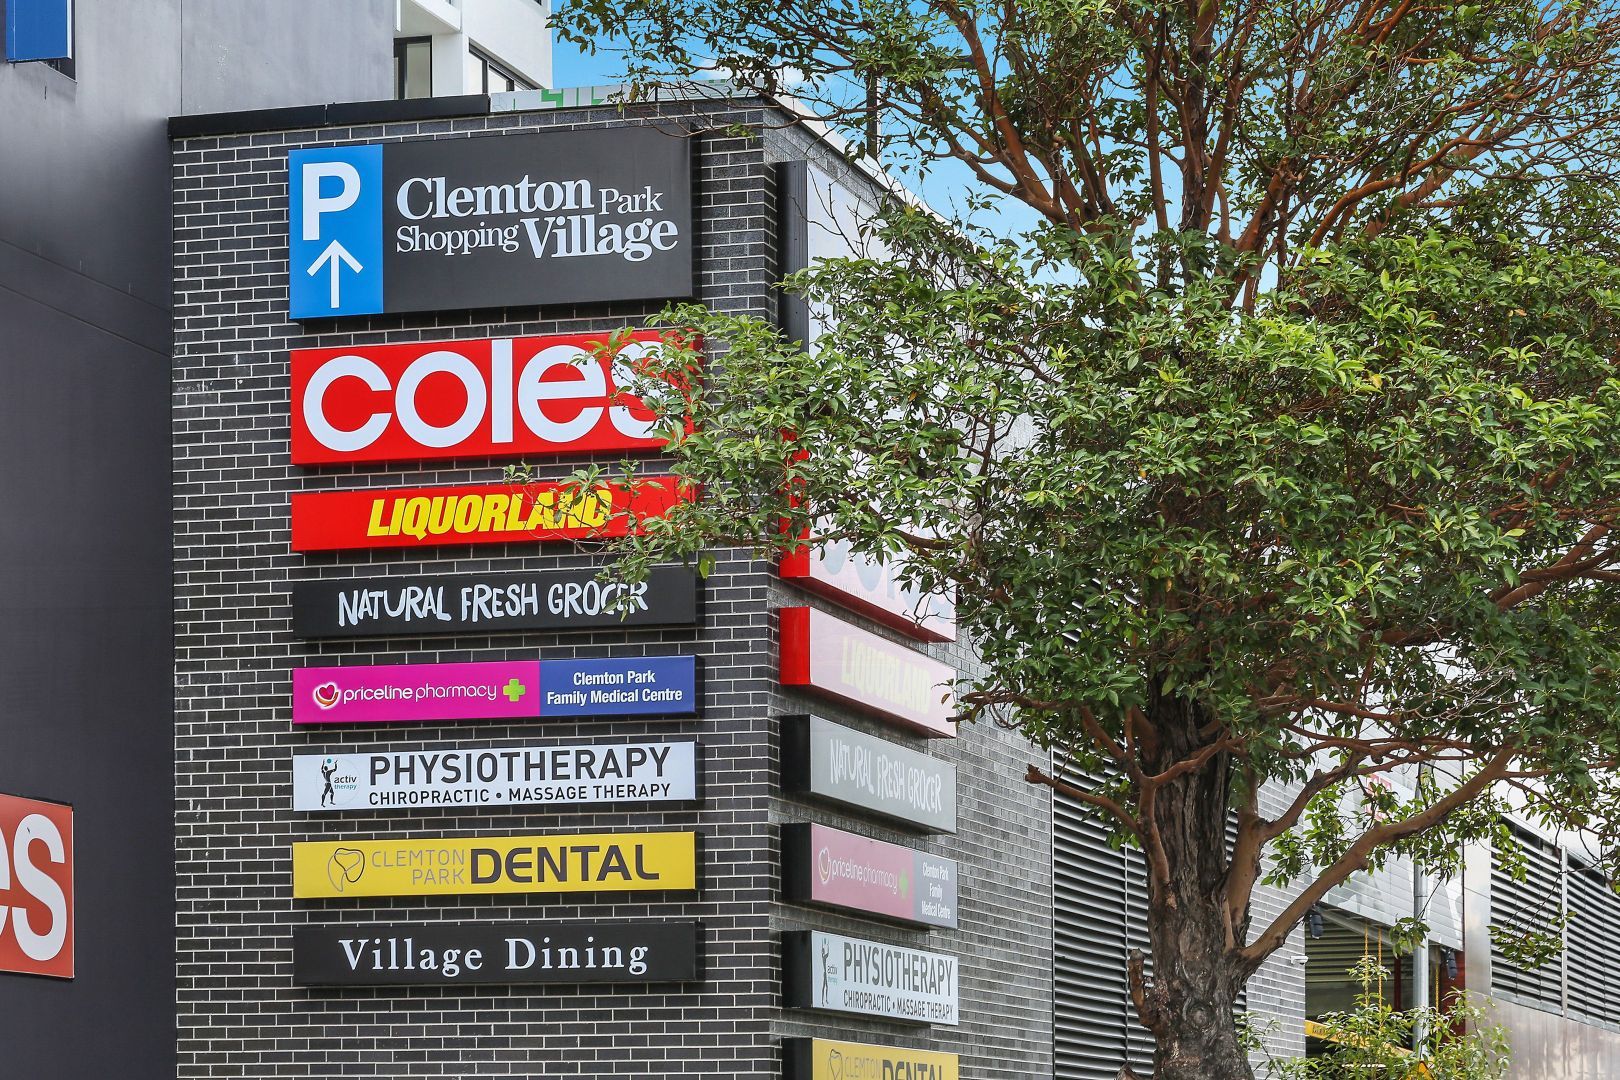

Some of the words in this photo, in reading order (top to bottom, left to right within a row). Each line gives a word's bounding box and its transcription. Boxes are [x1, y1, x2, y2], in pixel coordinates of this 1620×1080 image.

[302, 161, 361, 241] P
[396, 174, 594, 220] Clemton
[598, 185, 663, 215] Park
[396, 222, 519, 256] Shopping
[519, 214, 678, 262] Village
[303, 338, 683, 452] coles
[366, 489, 613, 541] LIQUORLAND
[338, 585, 451, 627] NATURAL
[461, 582, 538, 623] FRESH
[343, 685, 413, 704] priceline
[415, 683, 497, 702] pharmacy
[547, 690, 587, 706] Family
[590, 688, 638, 704] Medical
[641, 687, 683, 702] Centre
[573, 671, 623, 685] Clemton
[627, 669, 656, 684] Park
[333, 775, 357, 784] activ
[369, 746, 671, 786] PHYSIOTHERAPY
[830, 738, 874, 794] NATURAL
[877, 754, 905, 800] FRESH
[908, 767, 942, 814] GROCER
[334, 783, 357, 791] therapy
[369, 789, 490, 806] CHIROPRACTIC
[508, 786, 588, 801] MASSAGE
[593, 783, 671, 798] THERAPY
[371, 848, 465, 868] CLEMTON
[411, 868, 465, 885] PARK
[470, 844, 660, 884] DENTAL
[831, 857, 863, 881] priceline
[0, 813, 67, 961] s
[338, 937, 483, 977] Village
[504, 936, 649, 975] Dining
[843, 941, 953, 996] PHYSIOTHERAPY
[843, 989, 891, 1012] CHIROPRACTIC
[897, 998, 925, 1018] MASSAGE
[927, 1002, 953, 1020] THERAPY
